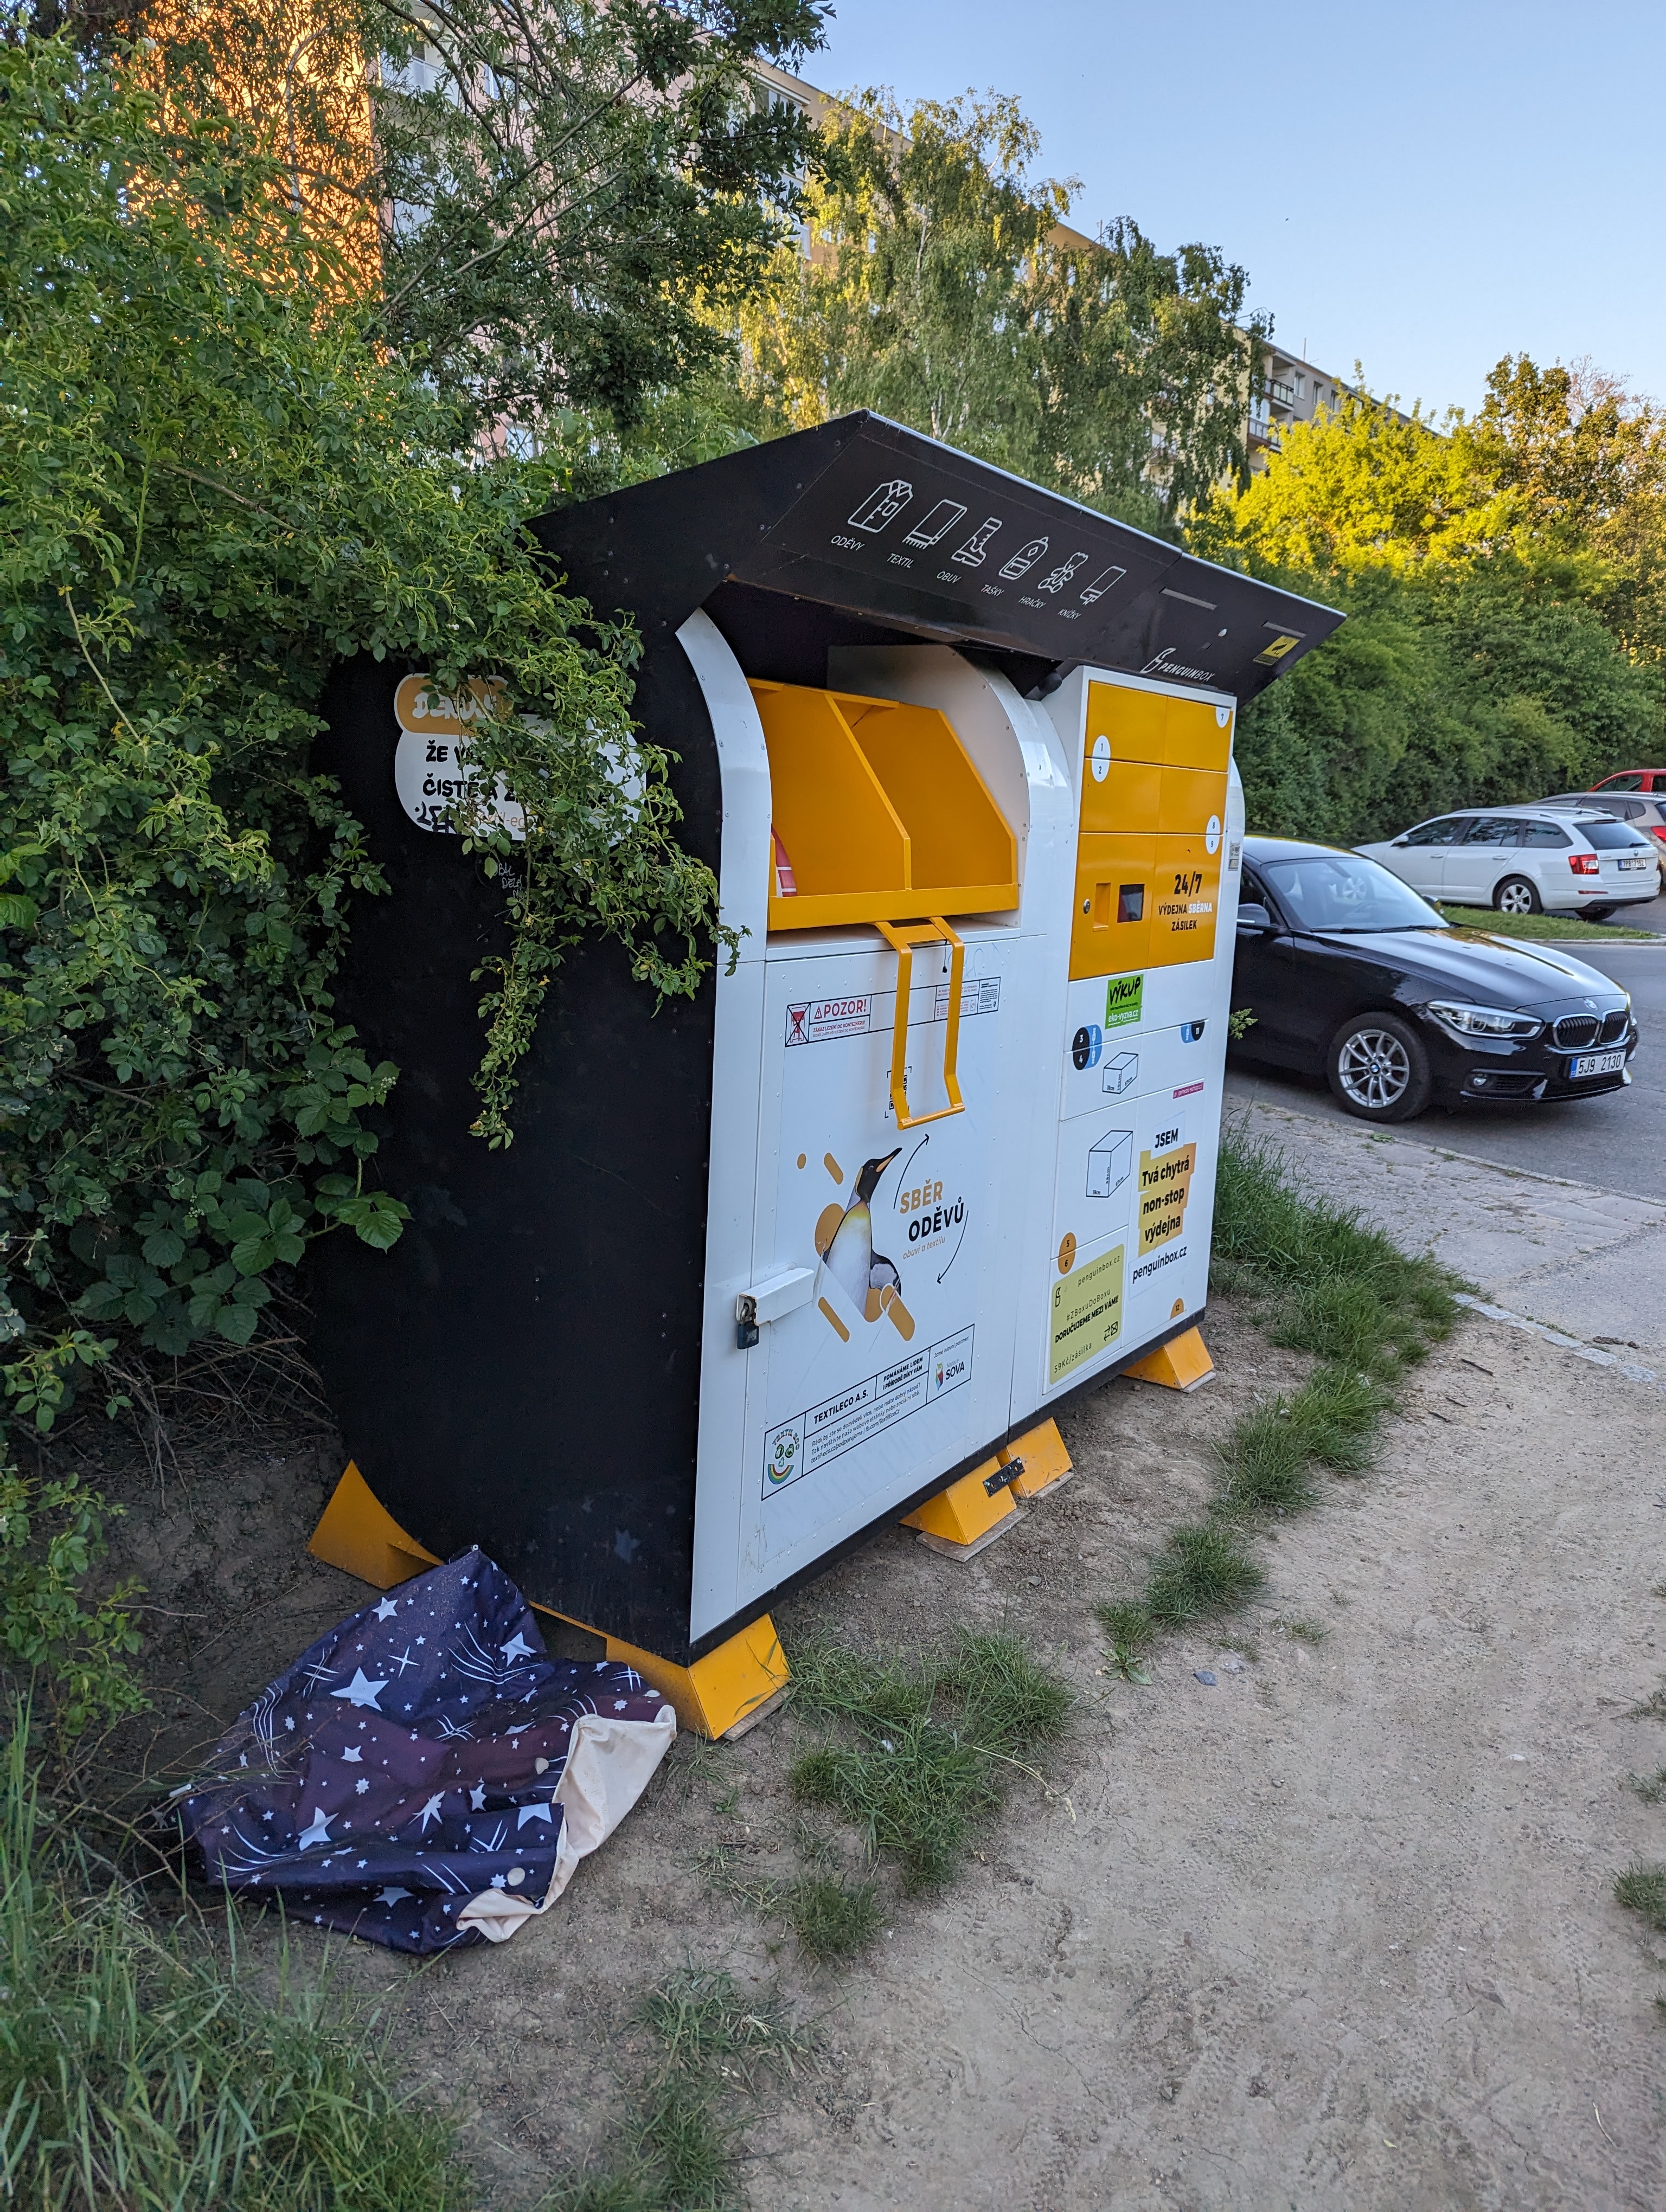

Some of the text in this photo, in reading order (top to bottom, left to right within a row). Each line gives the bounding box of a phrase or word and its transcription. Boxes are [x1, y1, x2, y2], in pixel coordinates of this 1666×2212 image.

[831, 535, 865, 551] ODĚVY
[887, 553, 914, 568] TEXTIL
[937, 571, 962, 583] OBUV
[981, 584, 1004, 596] TAŠKY
[1018, 595, 1047, 609] HRAČKY
[1058, 608, 1081, 620] KNÍŽKY
[1157, 662, 1216, 682] PENGUINBOX
[1221, 713, 1224, 721] 7
[425, 740, 448, 762] ŽE
[1101, 743, 1103, 752] 1
[1098, 766, 1102, 774] 2
[1174, 871, 1202, 897] 24/7
[1158, 901, 1213, 915] VÝDEJNA SBĚRNA
[1171, 918, 1197, 931] ZÁSILEK
[1110, 976, 1141, 1006] VÝKUP
[824, 999, 867, 1018] POZOR!
[1108, 1009, 1138, 1022] eko-vyzva.cz
[1079, 1034, 1084, 1043] 3
[1079, 1054, 1083, 1063] 4
[1579, 1058, 1595, 1074] 5J9
[1600, 1054, 1622, 1071] 2130
[1155, 1128, 1178, 1149] JSEM
[1142, 1154, 1189, 1187] Tvá chytrá
[899, 1179, 943, 1214] SBĚR
[1143, 1187, 1184, 1215] non-stop
[908, 1196, 964, 1242] ODĚVŮ
[1144, 1215, 1181, 1243] výdejna
[903, 1245, 920, 1259] obuvi
[927, 1236, 946, 1250] textilu
[1066, 1239, 1070, 1248] 5
[1078, 1256, 1120, 1288] penguinbox.cz
[1132, 1246, 1187, 1284] penguinbox.cz
[1066, 1289, 1111, 1322] #ZBoxuDoBoxu
[1055, 1295, 1119, 1343] DORUČUJEME MEZI VÁMI!
[933, 1336, 969, 1359] Jsme hlavní partner:
[1054, 1342, 1092, 1373] 59Kč/zásilka
[883, 1356, 923, 1382] POMÁHÁME LIDEM
[885, 1375, 903, 1390] PŘÍRODĚ
[903, 1371, 913, 1380] DÍKY
[913, 1364, 922, 1374] VÁM
[945, 1361, 965, 1380] SOVA
[812, 1436, 822, 1446] Rádi
[873, 1404, 883, 1413] nebo
[884, 1398, 894, 1407] máte
[895, 1390, 906, 1400] dobrý
[906, 1382, 921, 1394] nápad?
[813, 1389, 868, 1424] TEXTILECO A.S.
[811, 1446, 820, 1455] Tak
[869, 1410, 885, 1422] stránky
[886, 1404, 896, 1413] nebo
[896, 1396, 911, 1407] sociální
